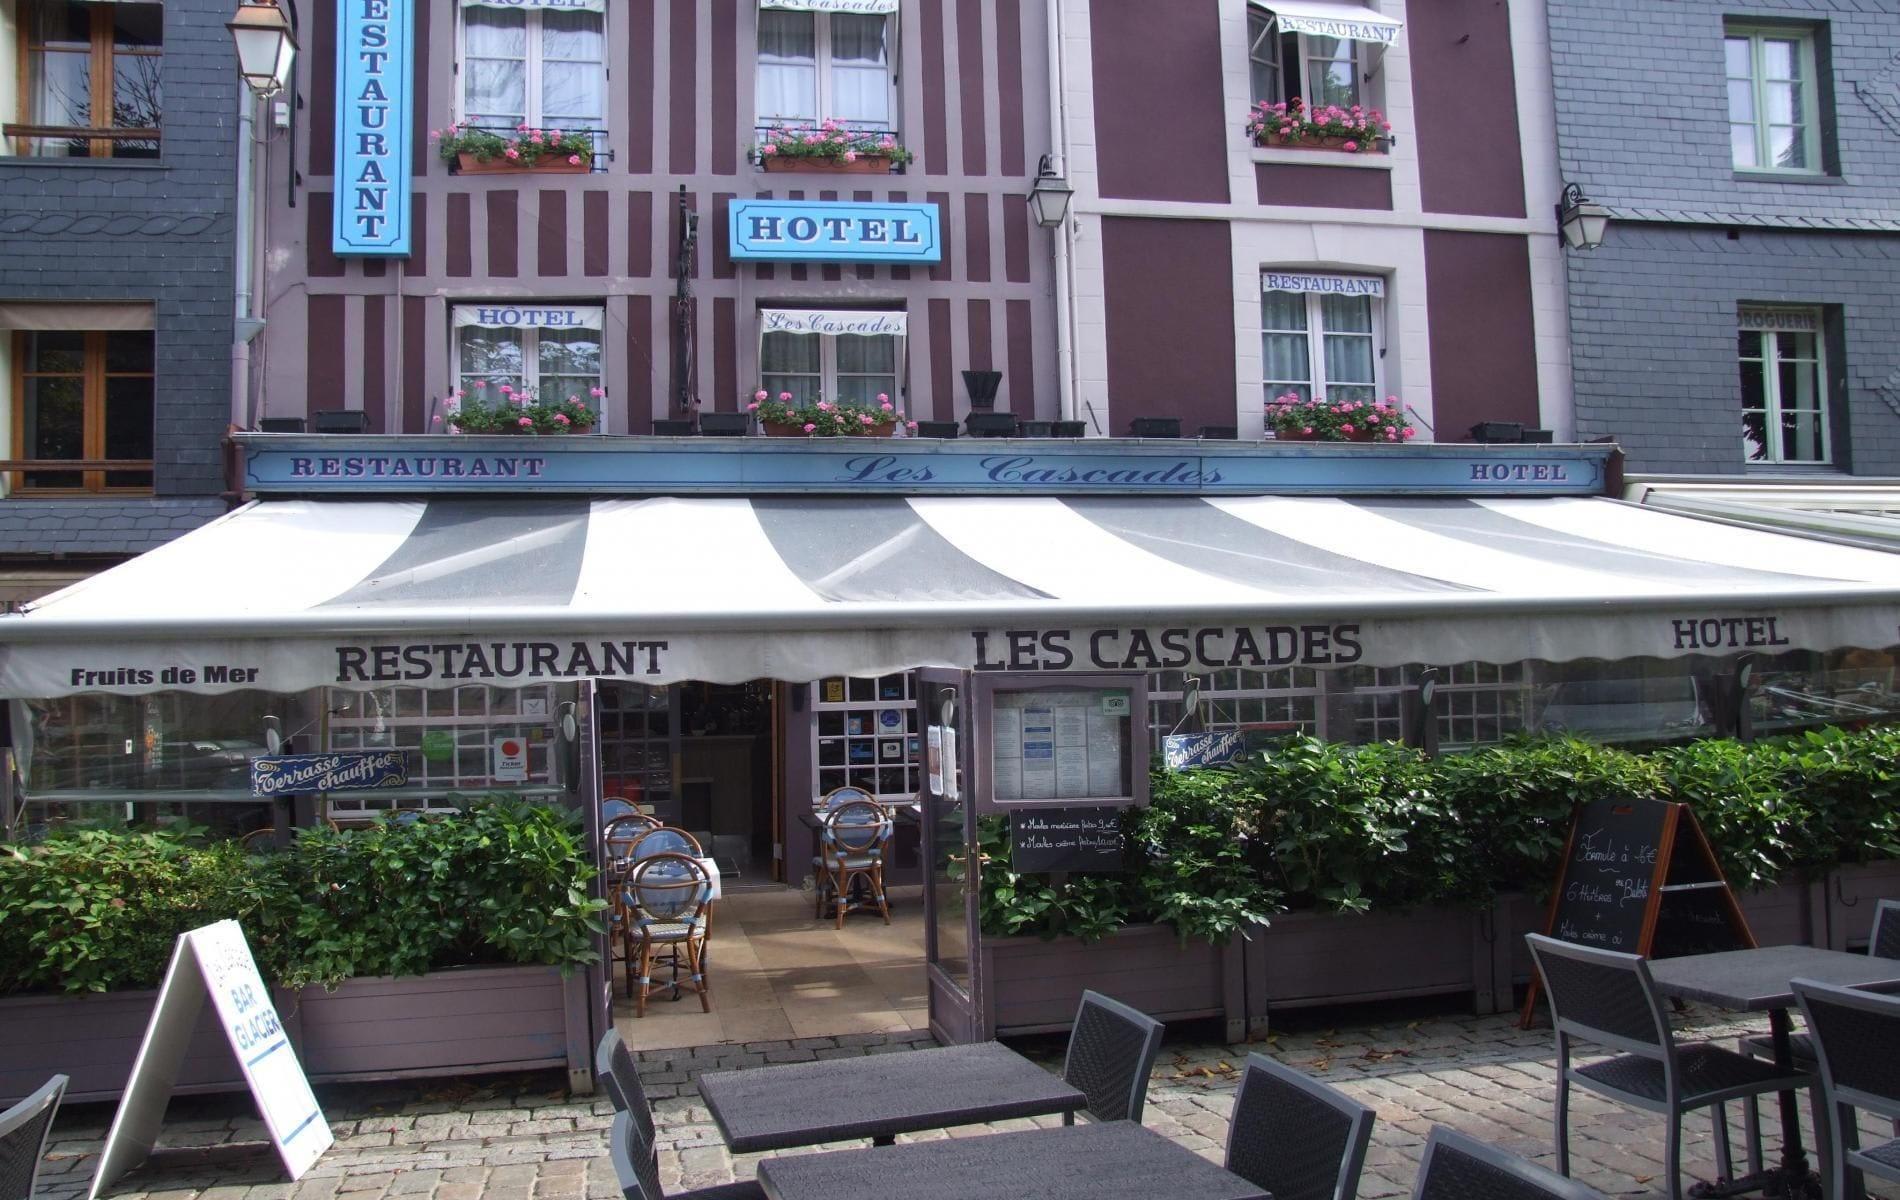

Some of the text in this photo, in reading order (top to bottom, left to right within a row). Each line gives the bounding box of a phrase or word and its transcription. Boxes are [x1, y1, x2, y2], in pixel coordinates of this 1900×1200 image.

[1280, 16, 1396, 42] RESTAURANT
[748, 216, 922, 245] HOTEL
[1267, 274, 1381, 294] RESTAURANT
[768, 312, 902, 333] Les Cascades
[290, 456, 546, 478] RESTAURANT
[834, 455, 1226, 485] Les Cascades
[1469, 463, 1569, 482] HOTEL
[971, 624, 1363, 671] LES CASCADES
[1672, 616, 1789, 649] HOTEL
[71, 665, 259, 686] Fruits de Mer
[335, 641, 668, 682] RESTAURANT
[1167, 734, 1213, 768] Terrasse
[258, 755, 341, 793] Terrasse
[230, 984, 258, 1014] BAR
[234, 1008, 281, 1051] GLACIER
